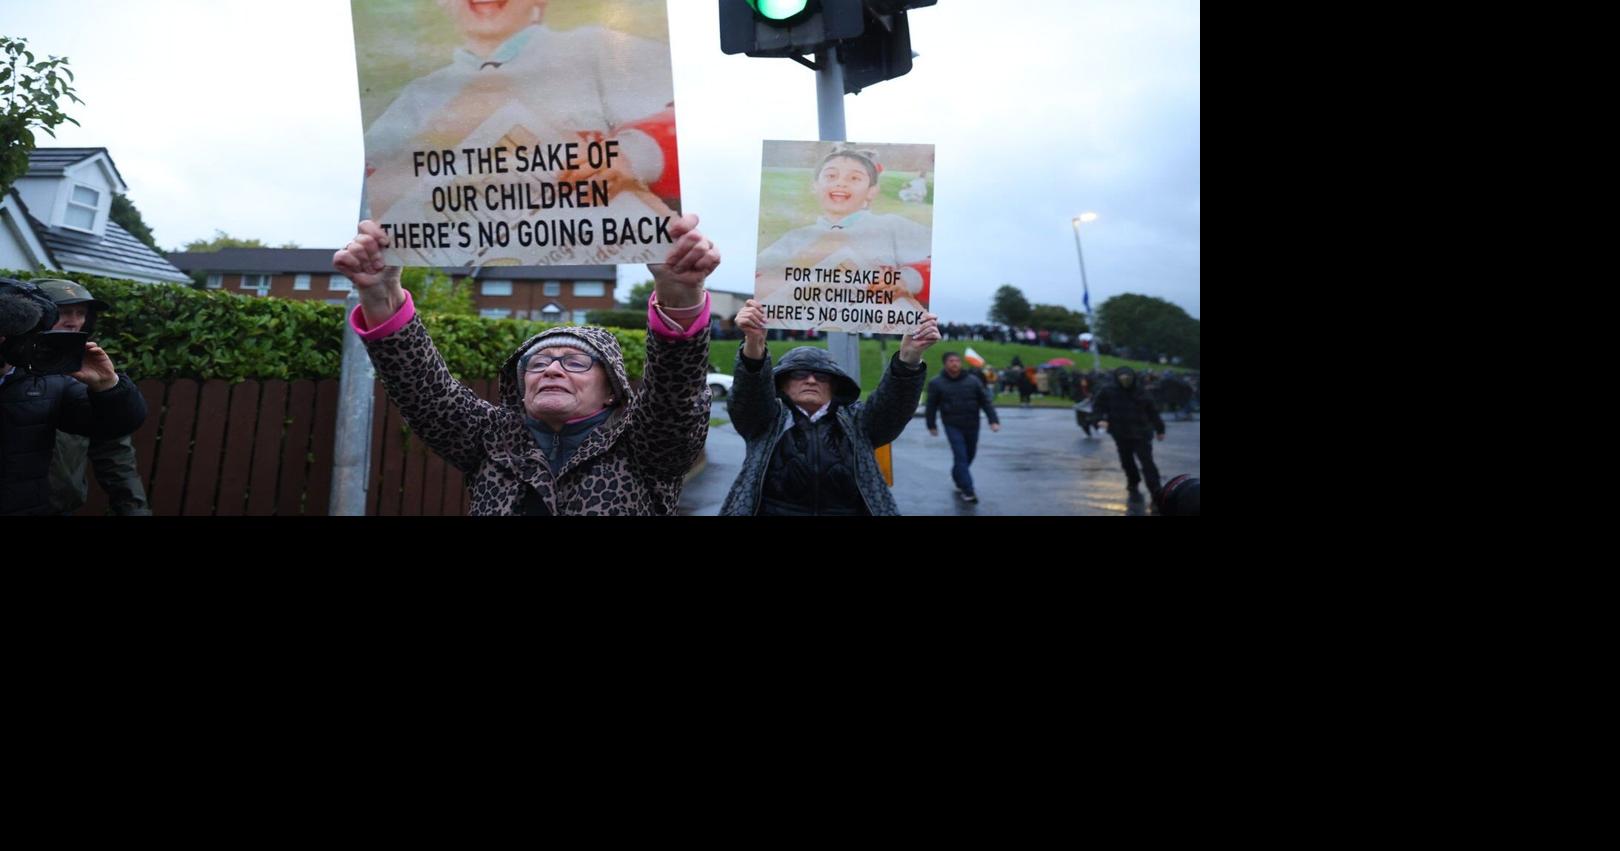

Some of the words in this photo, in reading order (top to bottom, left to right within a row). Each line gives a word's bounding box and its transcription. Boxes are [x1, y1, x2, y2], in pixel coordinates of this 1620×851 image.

[413, 150, 456, 177] FOR
[462, 146, 508, 175] THE
[515, 142, 580, 173] SAKE
[587, 141, 619, 169] OF
[432, 185, 478, 213] OUR
[485, 180, 609, 211] CHILDREN
[478, 221, 510, 248] NO
[517, 218, 594, 247] GOING
[602, 216, 673, 246] BACK
[785, 267, 811, 282] FOR
[815, 268, 841, 284] THE
[844, 269, 880, 285] SAKE
[883, 271, 901, 286] OF
[793, 286, 821, 302] OUR
[825, 288, 893, 305] CHILDREN
[762, 304, 815, 321] HERE'S
[818, 307, 838, 322] NO
[841, 308, 883, 324] GOING
[887, 310, 924, 325] BACK
